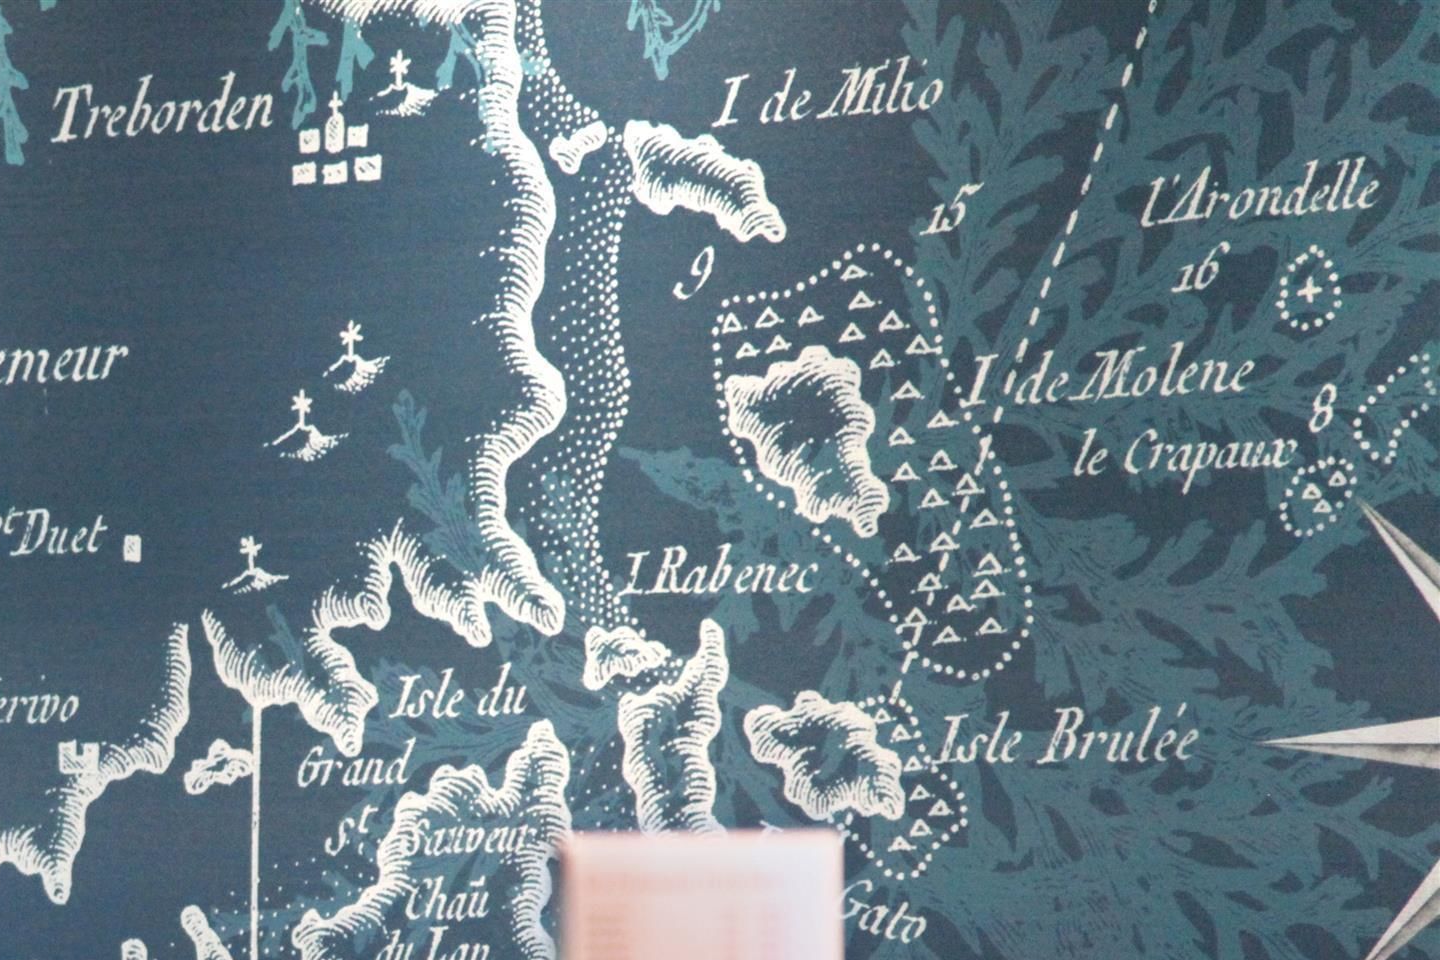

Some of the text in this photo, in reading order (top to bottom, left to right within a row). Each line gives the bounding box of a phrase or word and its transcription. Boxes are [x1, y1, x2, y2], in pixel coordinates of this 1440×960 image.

[51, 72, 274, 143] Treborden
[760, 67, 812, 124] de
[816, 55, 944, 120] Milio
[920, 182, 984, 236] 15
[1141, 156, 1379, 228] l'Arondelle
[673, 246, 714, 300] 9
[1171, 241, 1230, 293] 16
[1015, 350, 1069, 405] de
[1069, 341, 1255, 402] Molene
[1308, 384, 1337, 432] 8
[1073, 428, 1298, 494] le Crapaux
[10, 508, 108, 556] Duet
[645, 543, 818, 594] Rabenec
[389, 662, 527, 719] Isle du
[931, 702, 1199, 764] Isle Brulée
[298, 737, 416, 788] Grand
